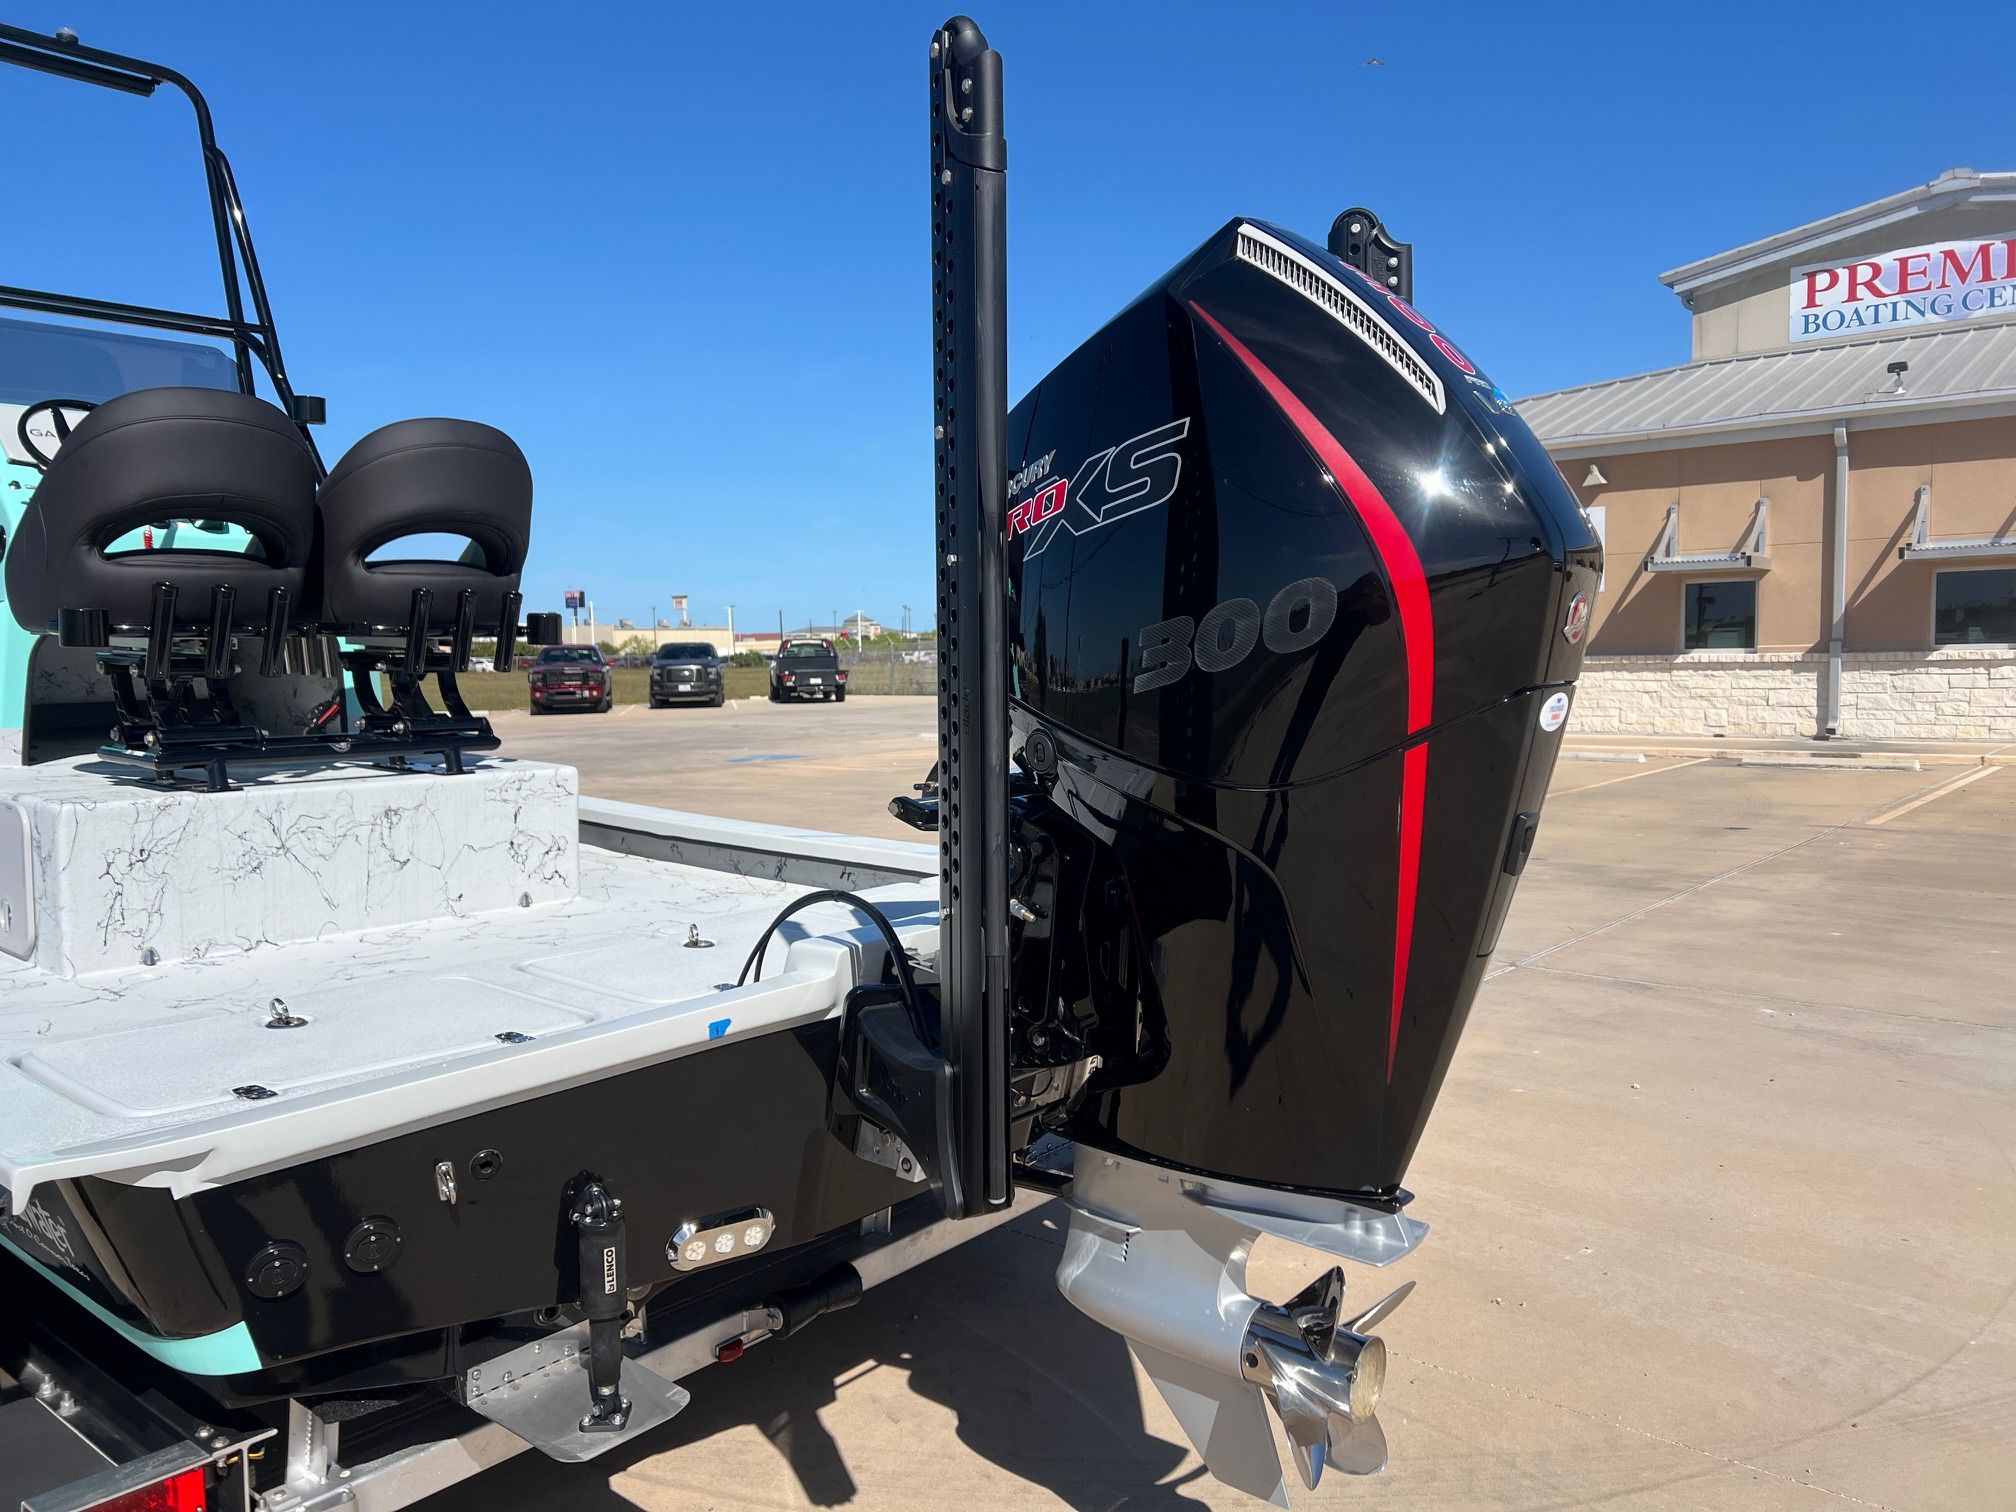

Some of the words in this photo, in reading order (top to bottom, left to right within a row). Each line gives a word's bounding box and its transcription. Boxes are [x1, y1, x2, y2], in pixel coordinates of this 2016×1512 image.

[1801, 293, 1954, 335] BOATING
[1022, 416, 1191, 562] XS
[1133, 576, 1338, 695] 300
[605, 1249, 615, 1284] LENCO
